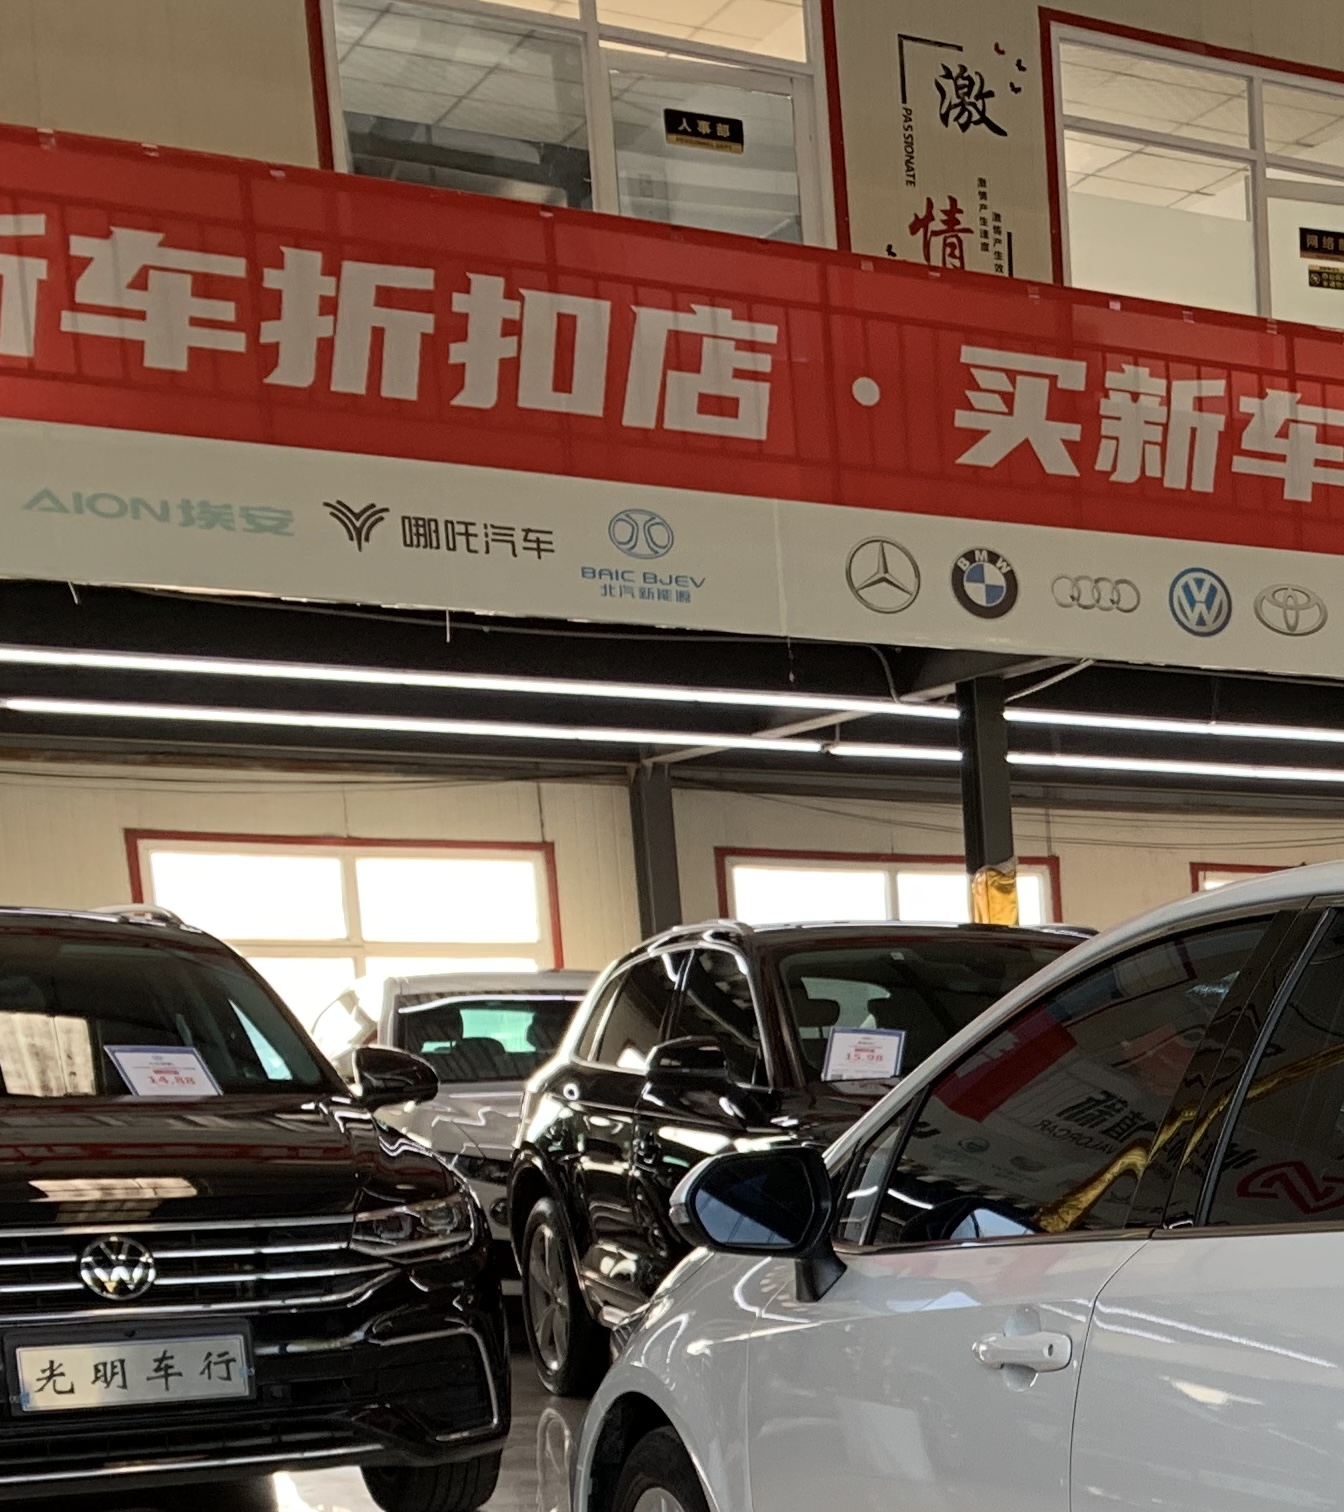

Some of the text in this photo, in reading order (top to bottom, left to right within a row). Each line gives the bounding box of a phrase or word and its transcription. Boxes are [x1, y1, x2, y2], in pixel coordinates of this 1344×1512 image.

[902, 106, 916, 188] PASSIONATE
[0, 213, 778, 442] 车折扣店
[22, 487, 295, 537] AION 埃安
[401, 514, 556, 561] 哪吒汽车
[581, 566, 706, 589] BAIC BJEV
[35, 1348, 238, 1396] 光明车行
